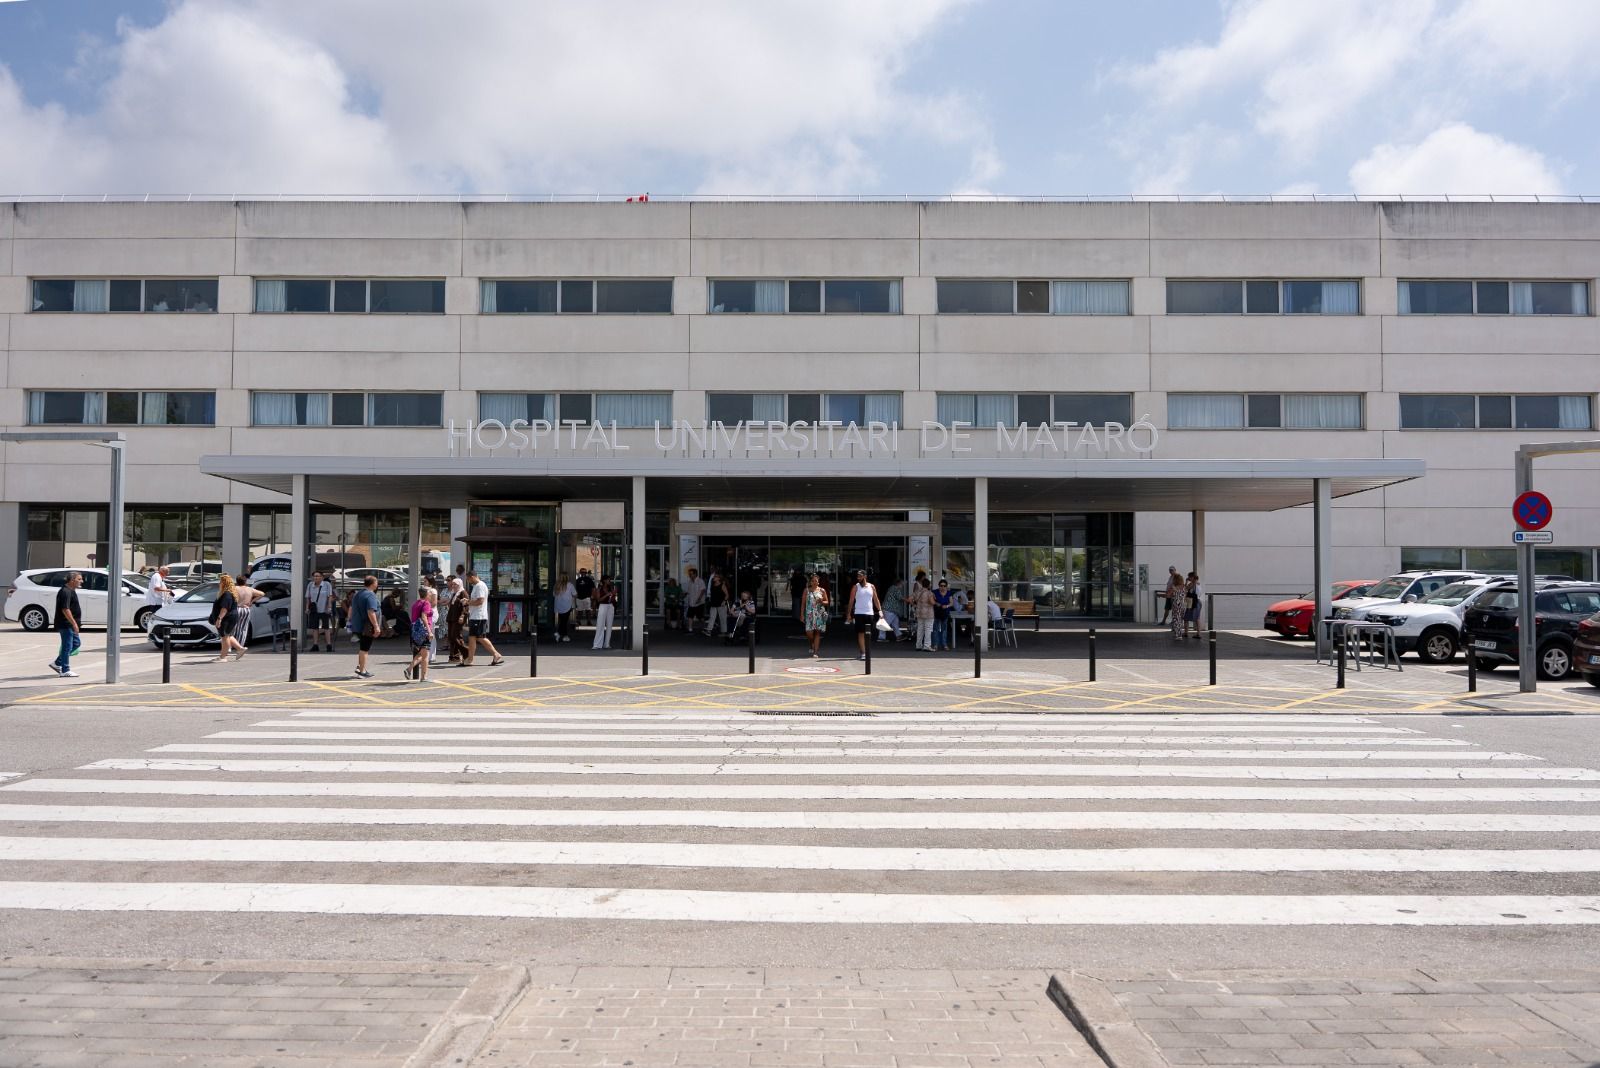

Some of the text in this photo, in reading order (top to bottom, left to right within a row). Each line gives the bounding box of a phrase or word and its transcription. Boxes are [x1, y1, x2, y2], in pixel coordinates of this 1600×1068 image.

[447, 413, 1159, 453] HOSPITAL UNIVERSITARI DE MATARÓ
